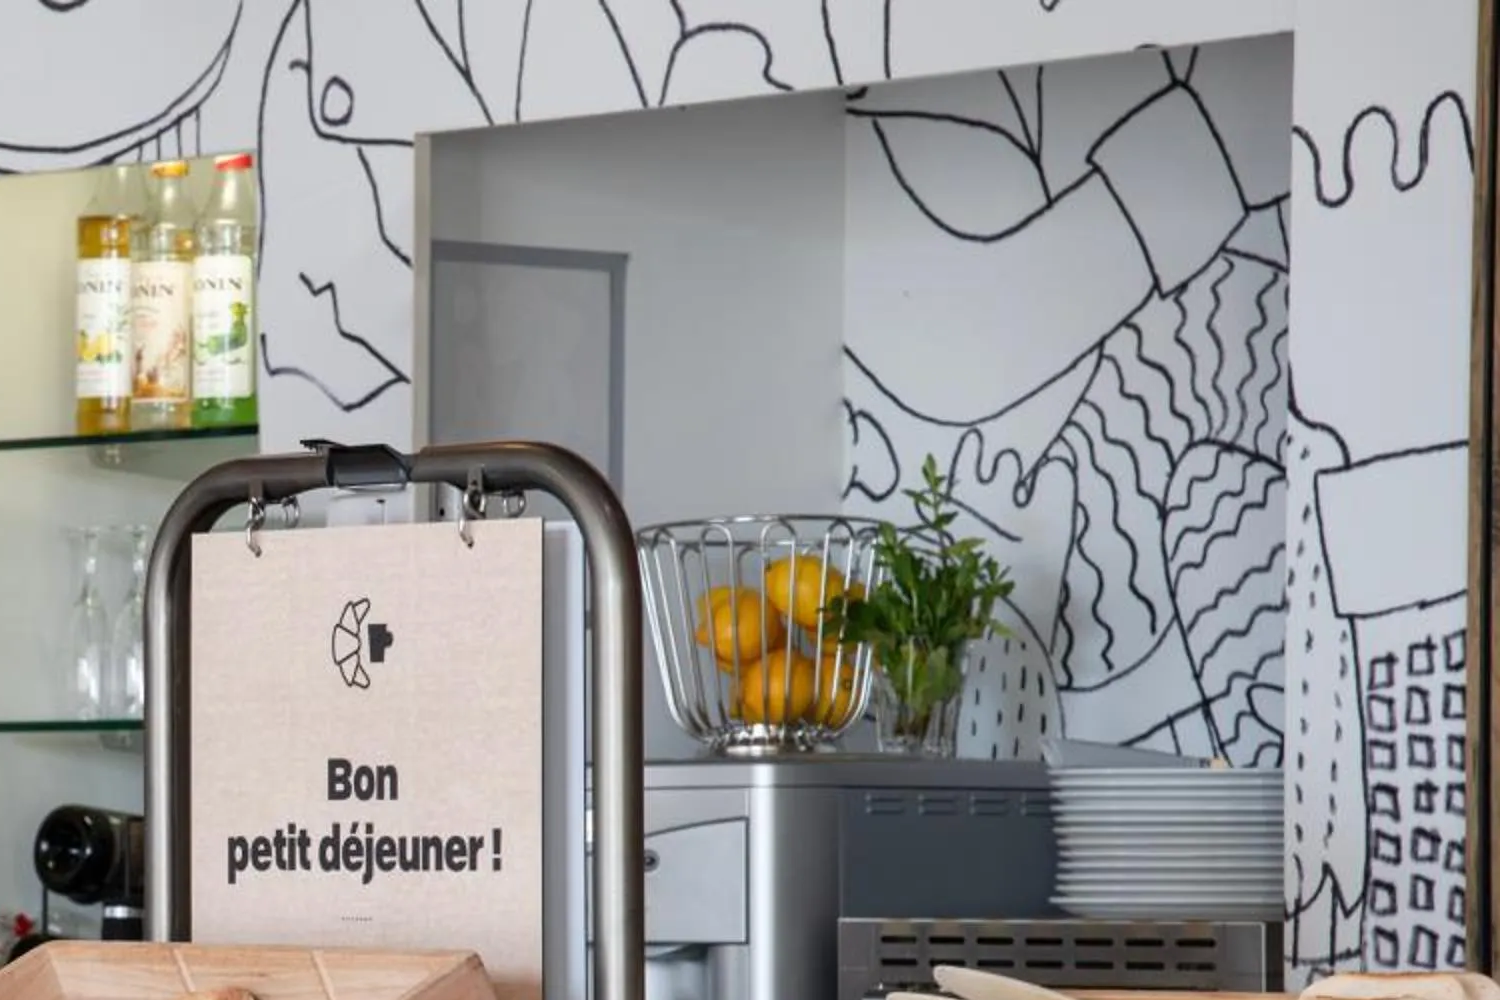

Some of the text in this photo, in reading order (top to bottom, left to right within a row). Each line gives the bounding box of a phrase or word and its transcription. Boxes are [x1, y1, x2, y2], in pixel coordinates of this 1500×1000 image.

[193, 276, 243, 291] ONIN
[327, 758, 398, 801] Bon
[227, 822, 311, 884] petit
[318, 822, 484, 884] déjeuner
